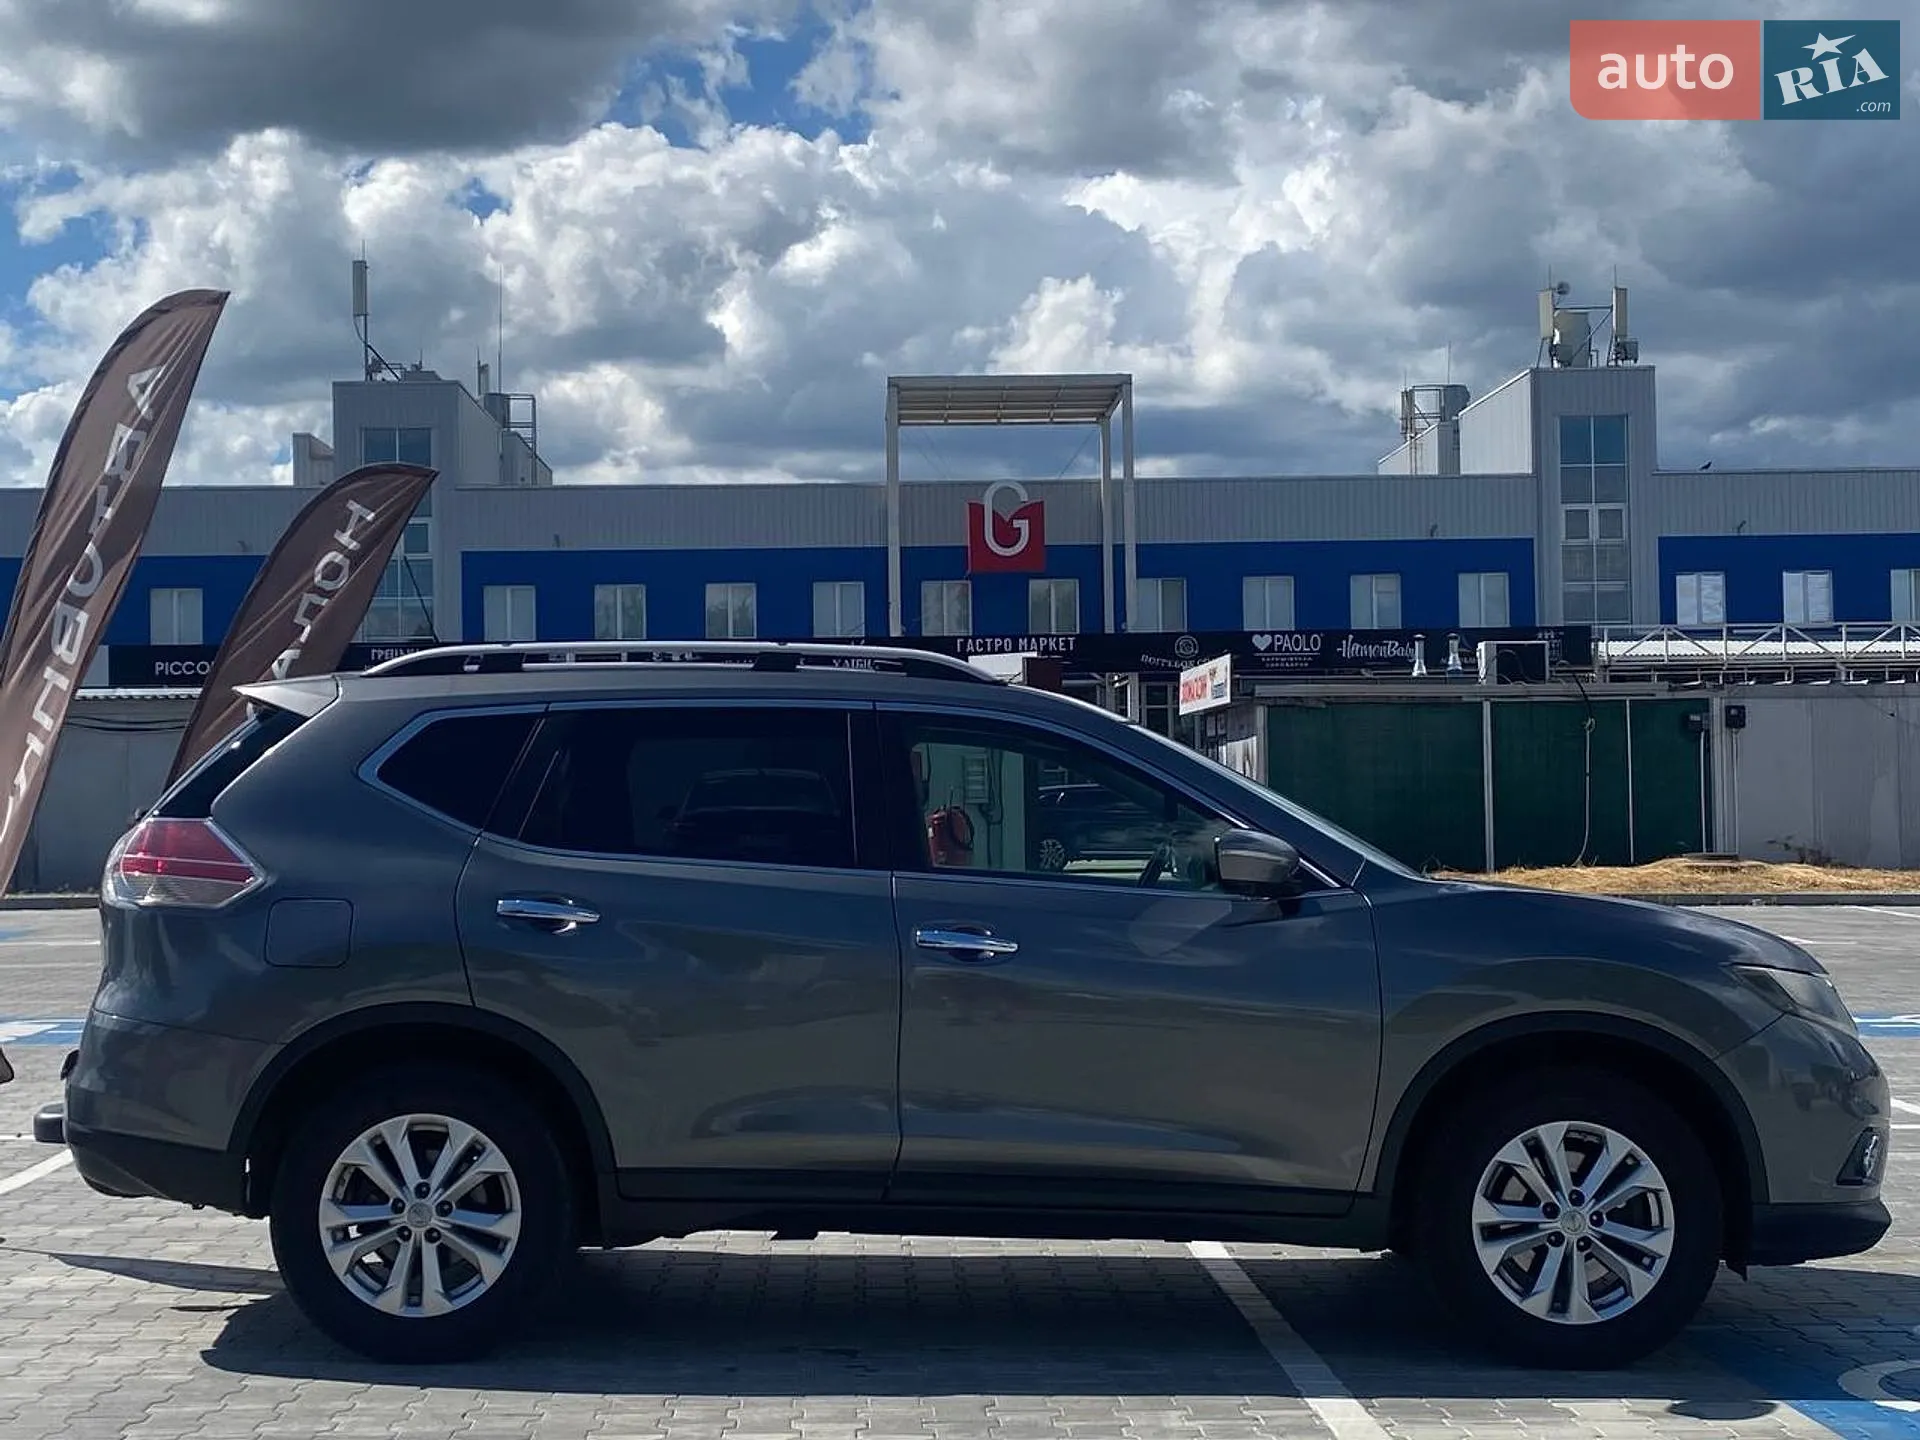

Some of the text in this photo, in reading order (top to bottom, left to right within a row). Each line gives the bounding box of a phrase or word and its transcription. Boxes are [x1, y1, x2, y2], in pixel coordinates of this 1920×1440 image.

[956, 637, 1076, 653] ГАСТРО МАРКЕТ
[1274, 634, 1321, 652] PAOLO
[155, 660, 215, 676] PICCO
